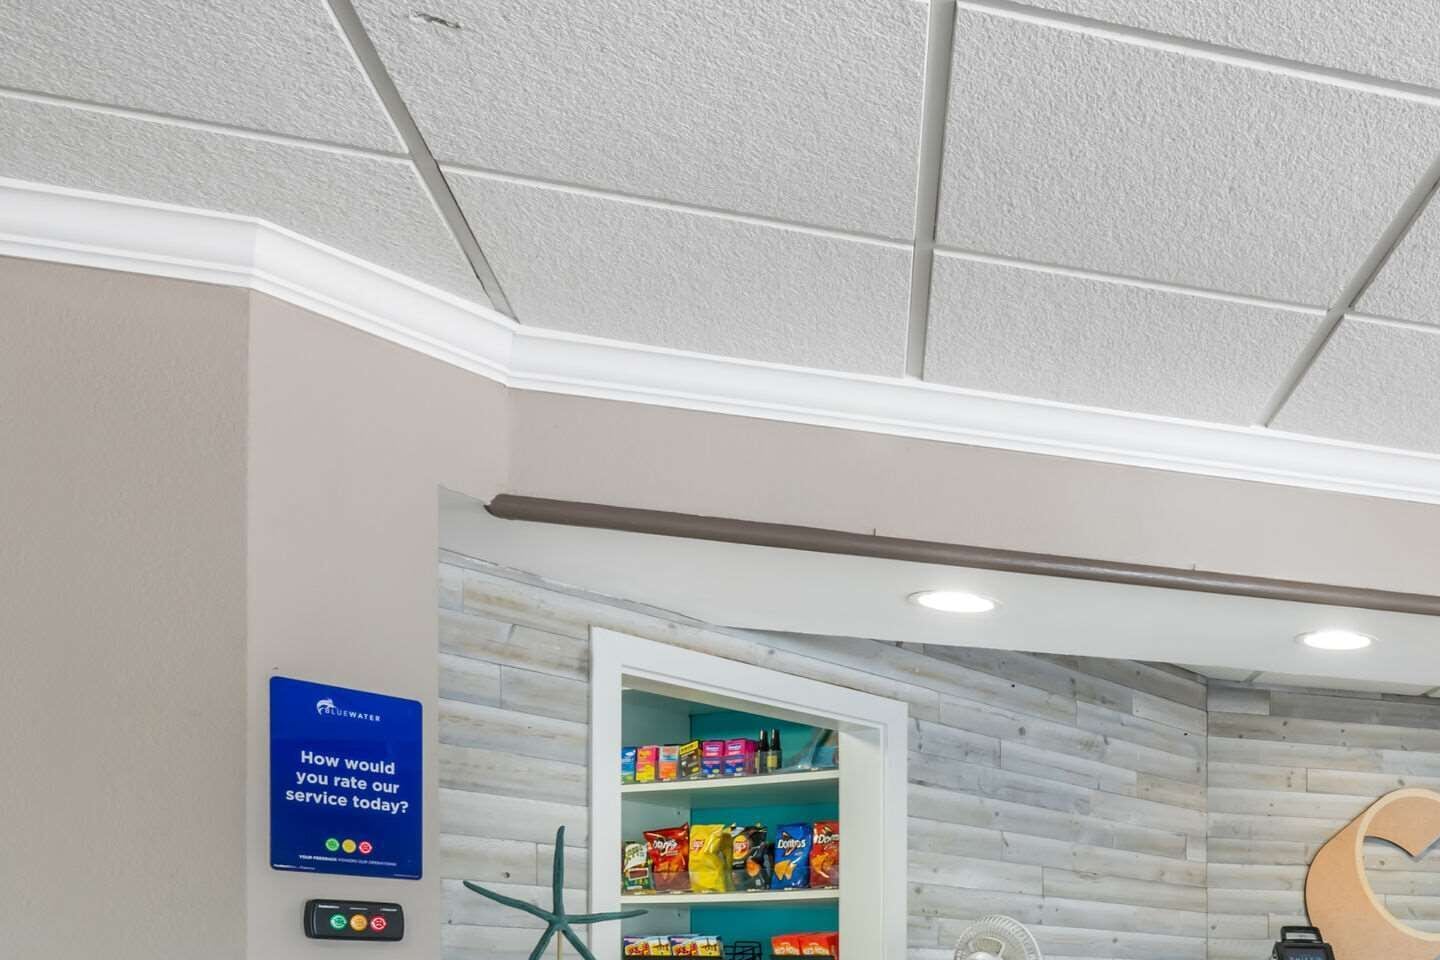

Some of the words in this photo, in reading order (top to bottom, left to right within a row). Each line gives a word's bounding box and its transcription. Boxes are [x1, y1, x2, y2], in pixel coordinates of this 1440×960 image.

[325, 707, 381, 722] BLUEWATER
[301, 750, 340, 768] How
[345, 758, 396, 775] would
[296, 771, 329, 785] you
[334, 776, 368, 790] rate
[372, 781, 400, 794] our
[285, 790, 348, 807] service
[352, 795, 409, 815] today?
[777, 839, 806, 849] Doritos
